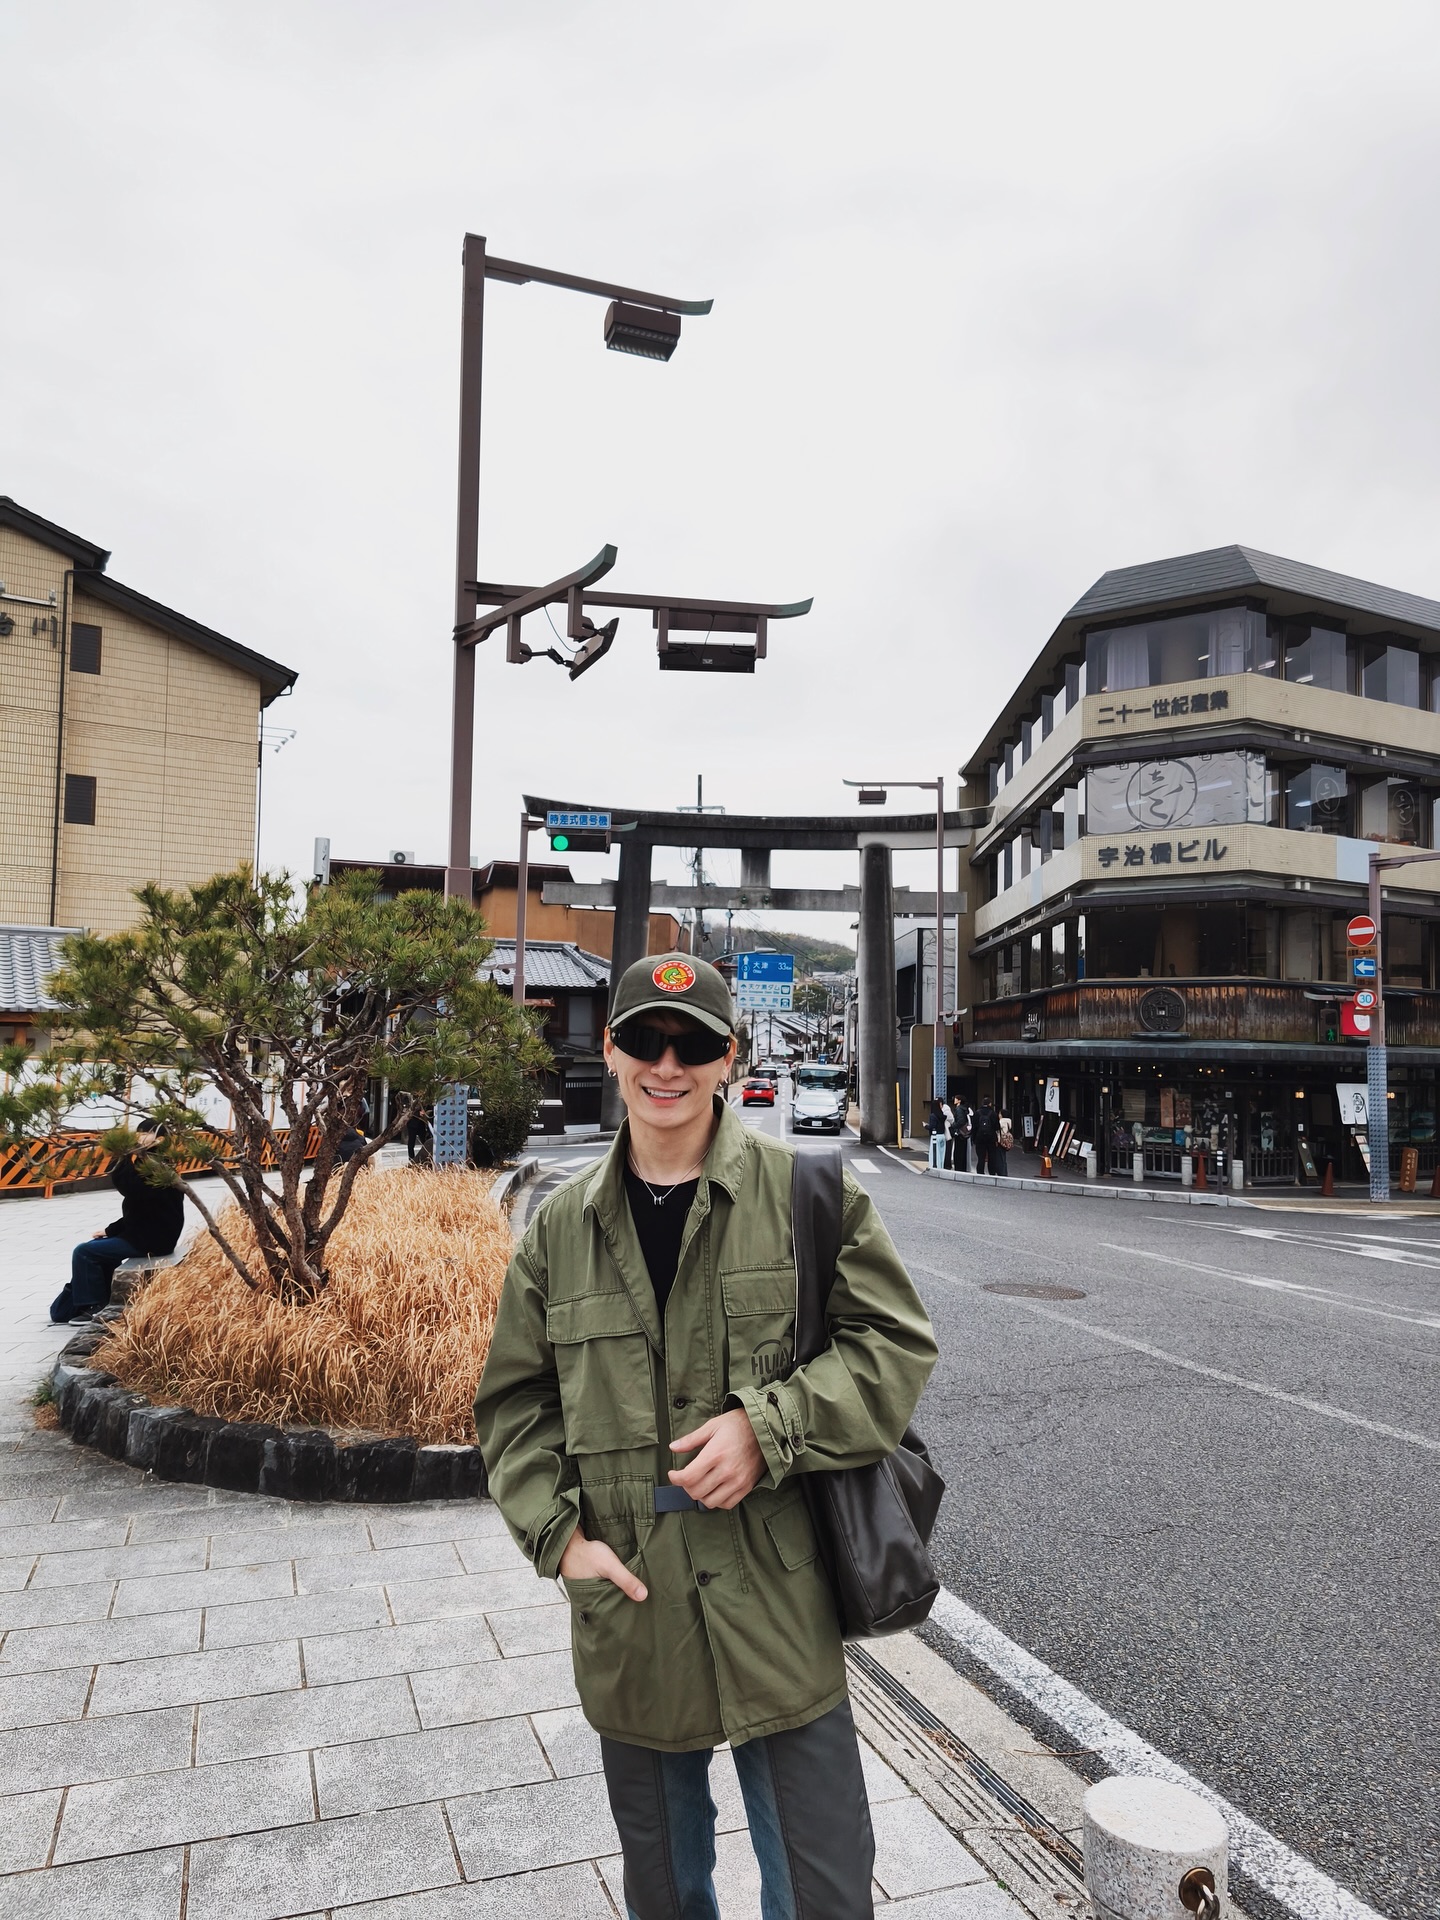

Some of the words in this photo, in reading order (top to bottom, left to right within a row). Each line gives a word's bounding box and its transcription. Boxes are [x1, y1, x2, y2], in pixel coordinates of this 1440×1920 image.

[550, 814, 607, 826] 時差式信号機
[1098, 838, 1227, 868] 宇治橋ビル
[1359, 994, 1372, 1004] 30
